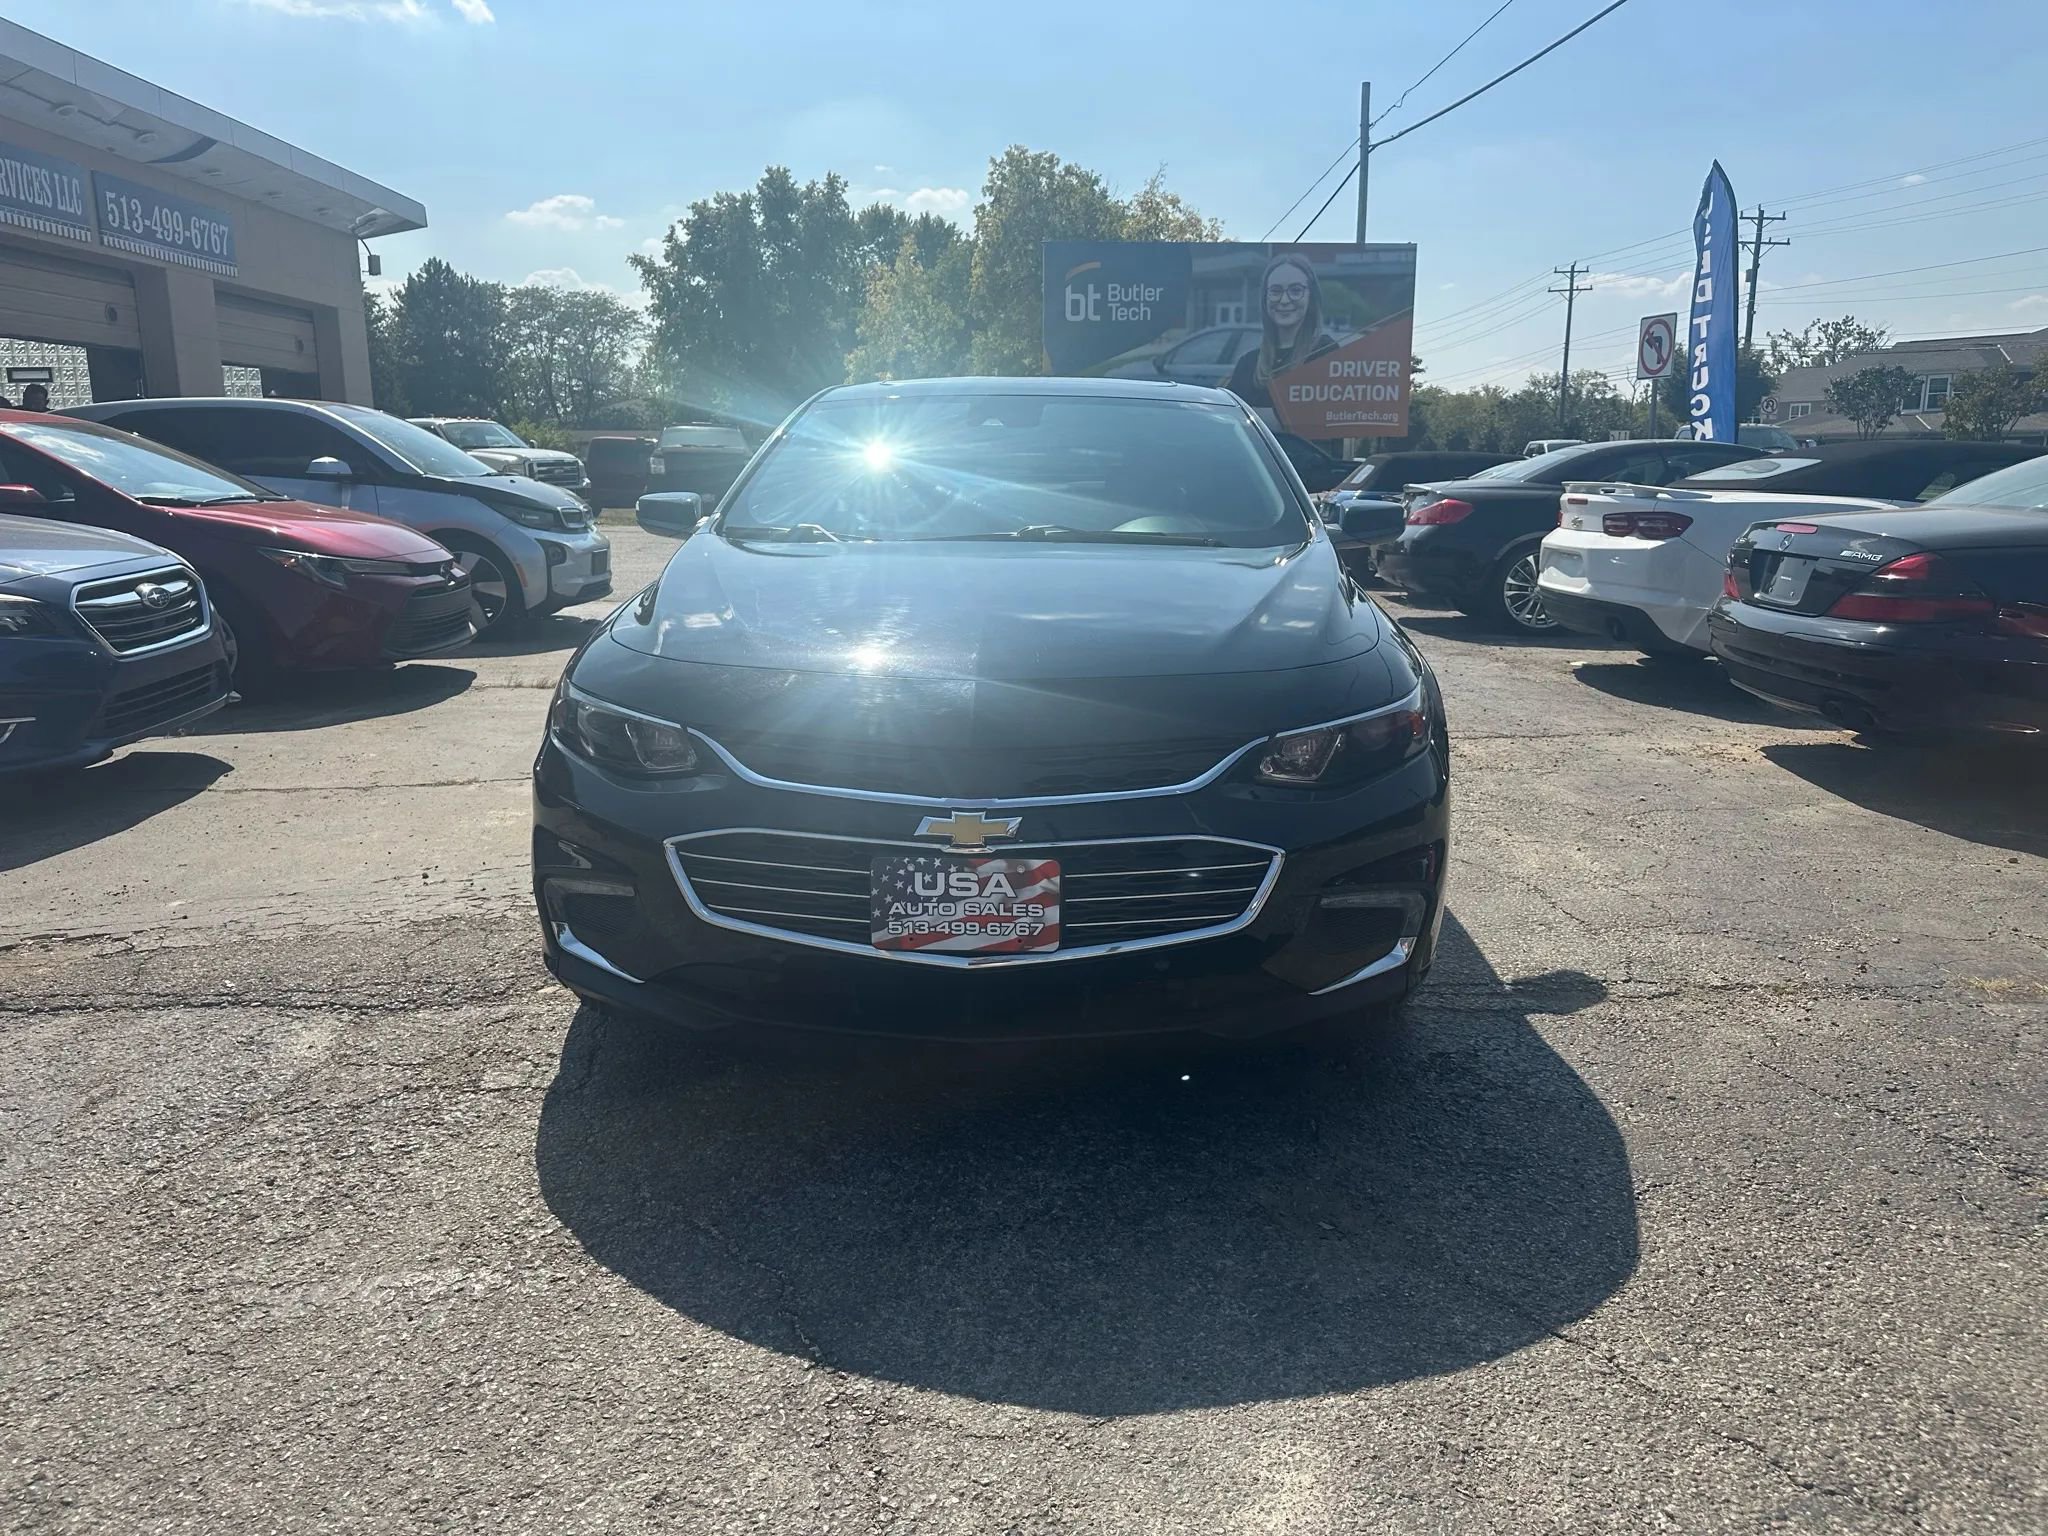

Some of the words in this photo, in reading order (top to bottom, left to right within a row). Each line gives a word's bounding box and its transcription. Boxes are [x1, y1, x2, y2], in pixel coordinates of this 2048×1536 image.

[53, 172, 82, 216] LLC
[106, 191, 229, 256] 513-499-6767
[1108, 283, 1164, 302] Butler
[1065, 284, 1101, 322] bt
[1108, 303, 1151, 321] Tech
[1329, 360, 1400, 378] DRIVER
[1289, 385, 1399, 402] EDUCATION
[1326, 411, 1399, 424] ButlerTech.org
[1852, 551, 1883, 561] AMG
[914, 872, 1017, 898] USA
[888, 902, 956, 916] AUTO
[964, 902, 1044, 917] SALES
[888, 920, 1044, 936] 513-499-6767
